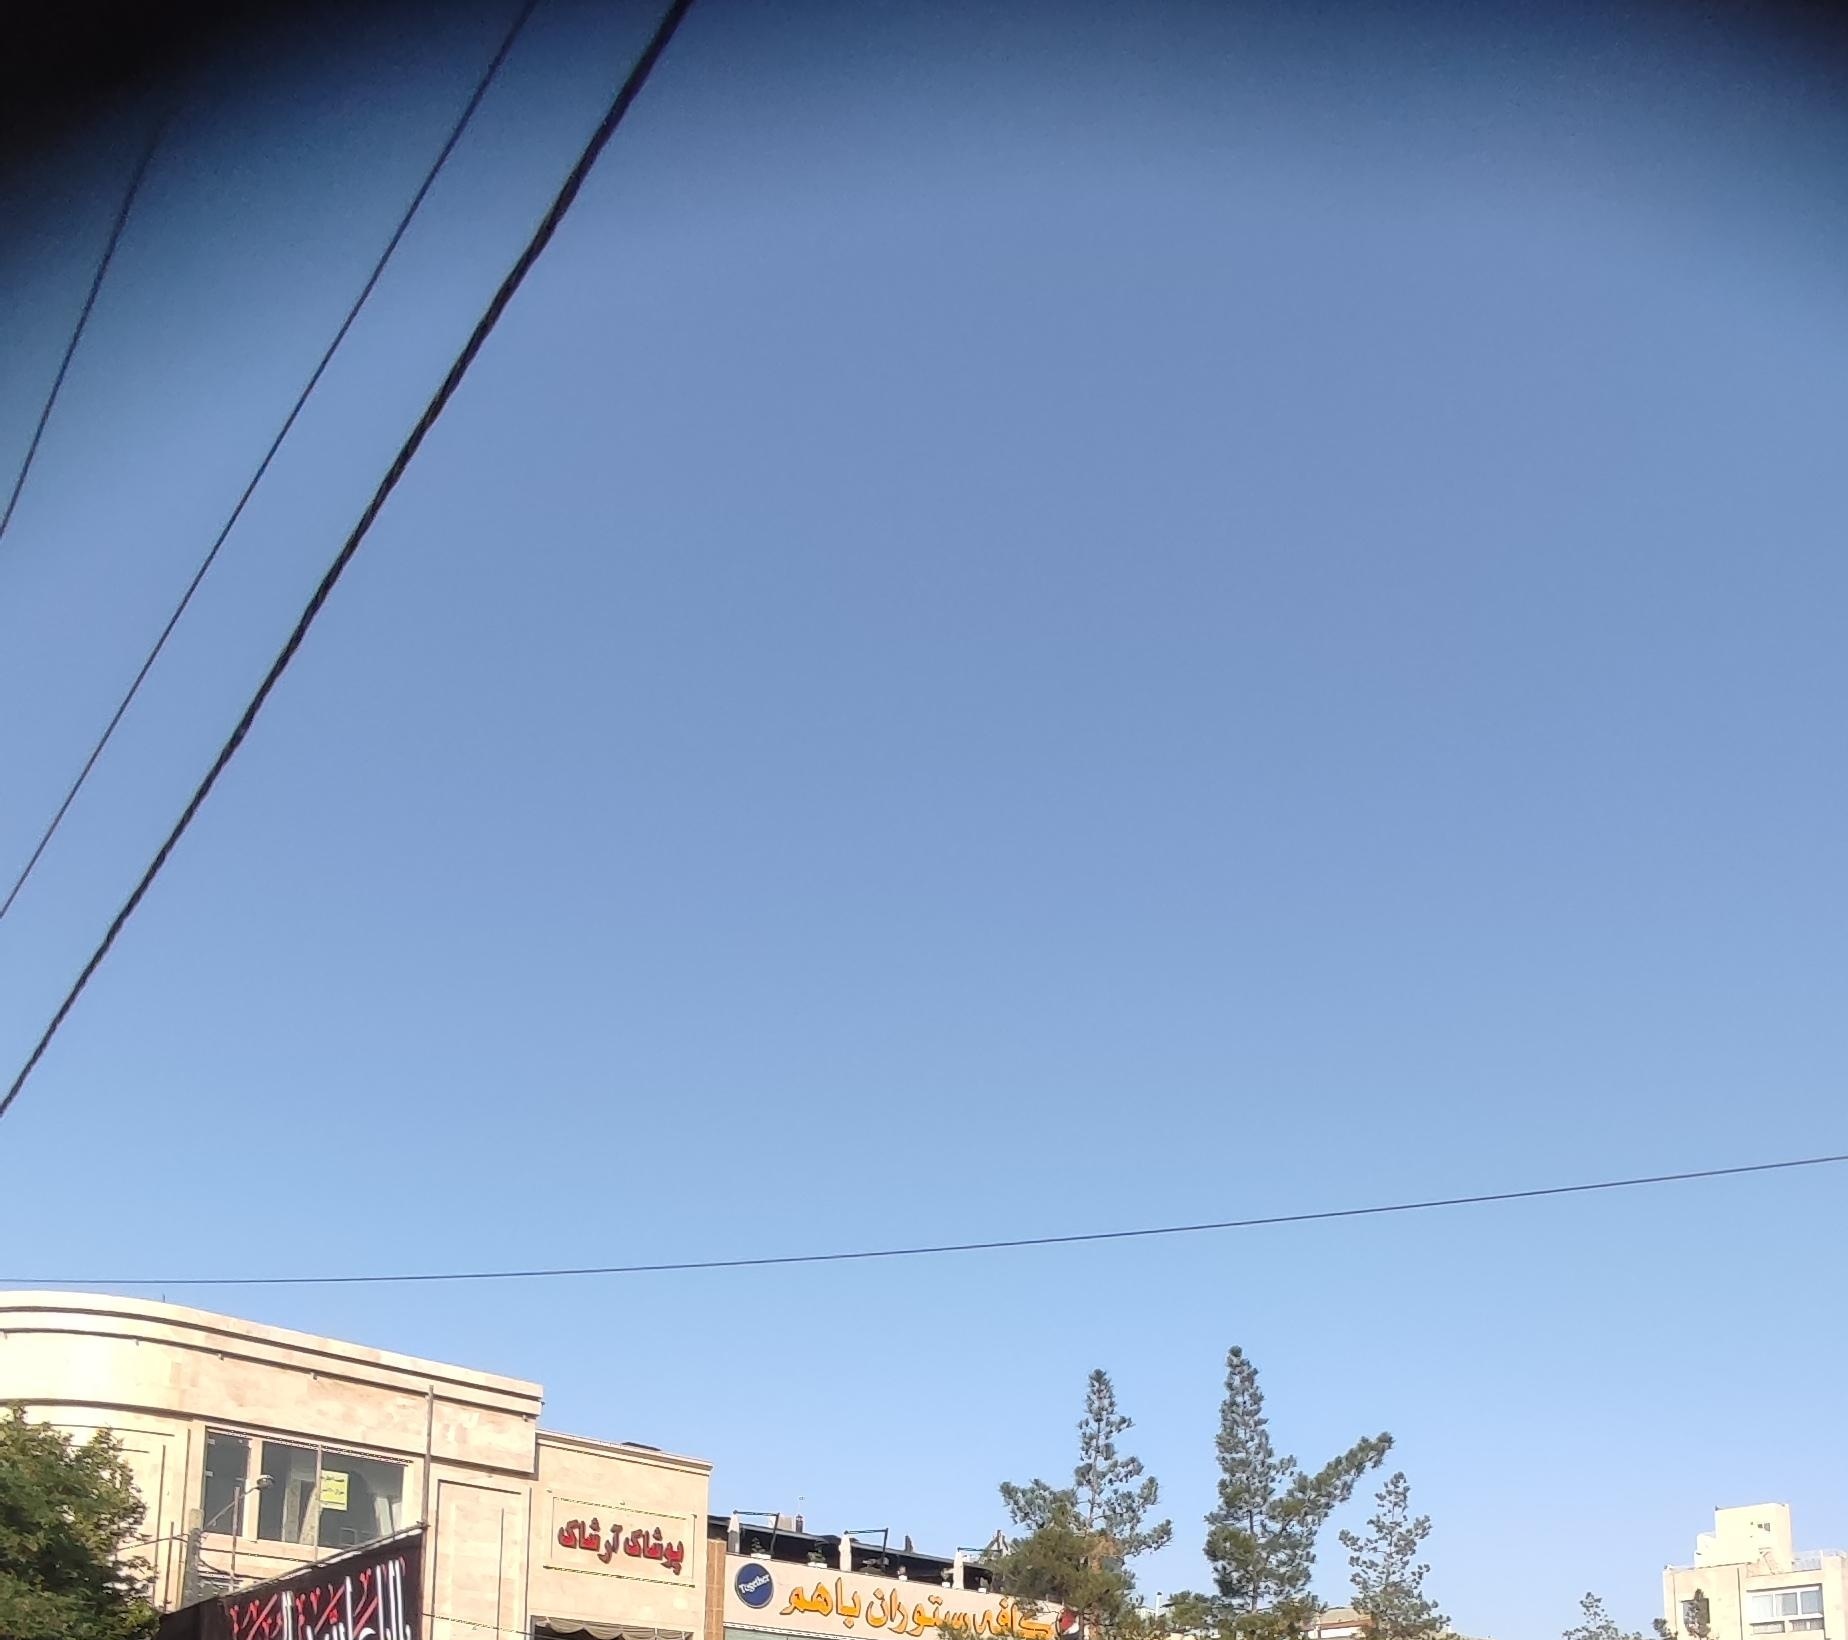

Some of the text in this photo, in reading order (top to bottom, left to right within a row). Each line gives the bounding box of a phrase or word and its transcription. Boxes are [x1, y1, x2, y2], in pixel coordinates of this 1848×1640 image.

[557, 1517, 685, 1576] پوشاک آرشاک
[738, 1573, 771, 1595] Together
[779, 1576, 861, 1629] باهم
